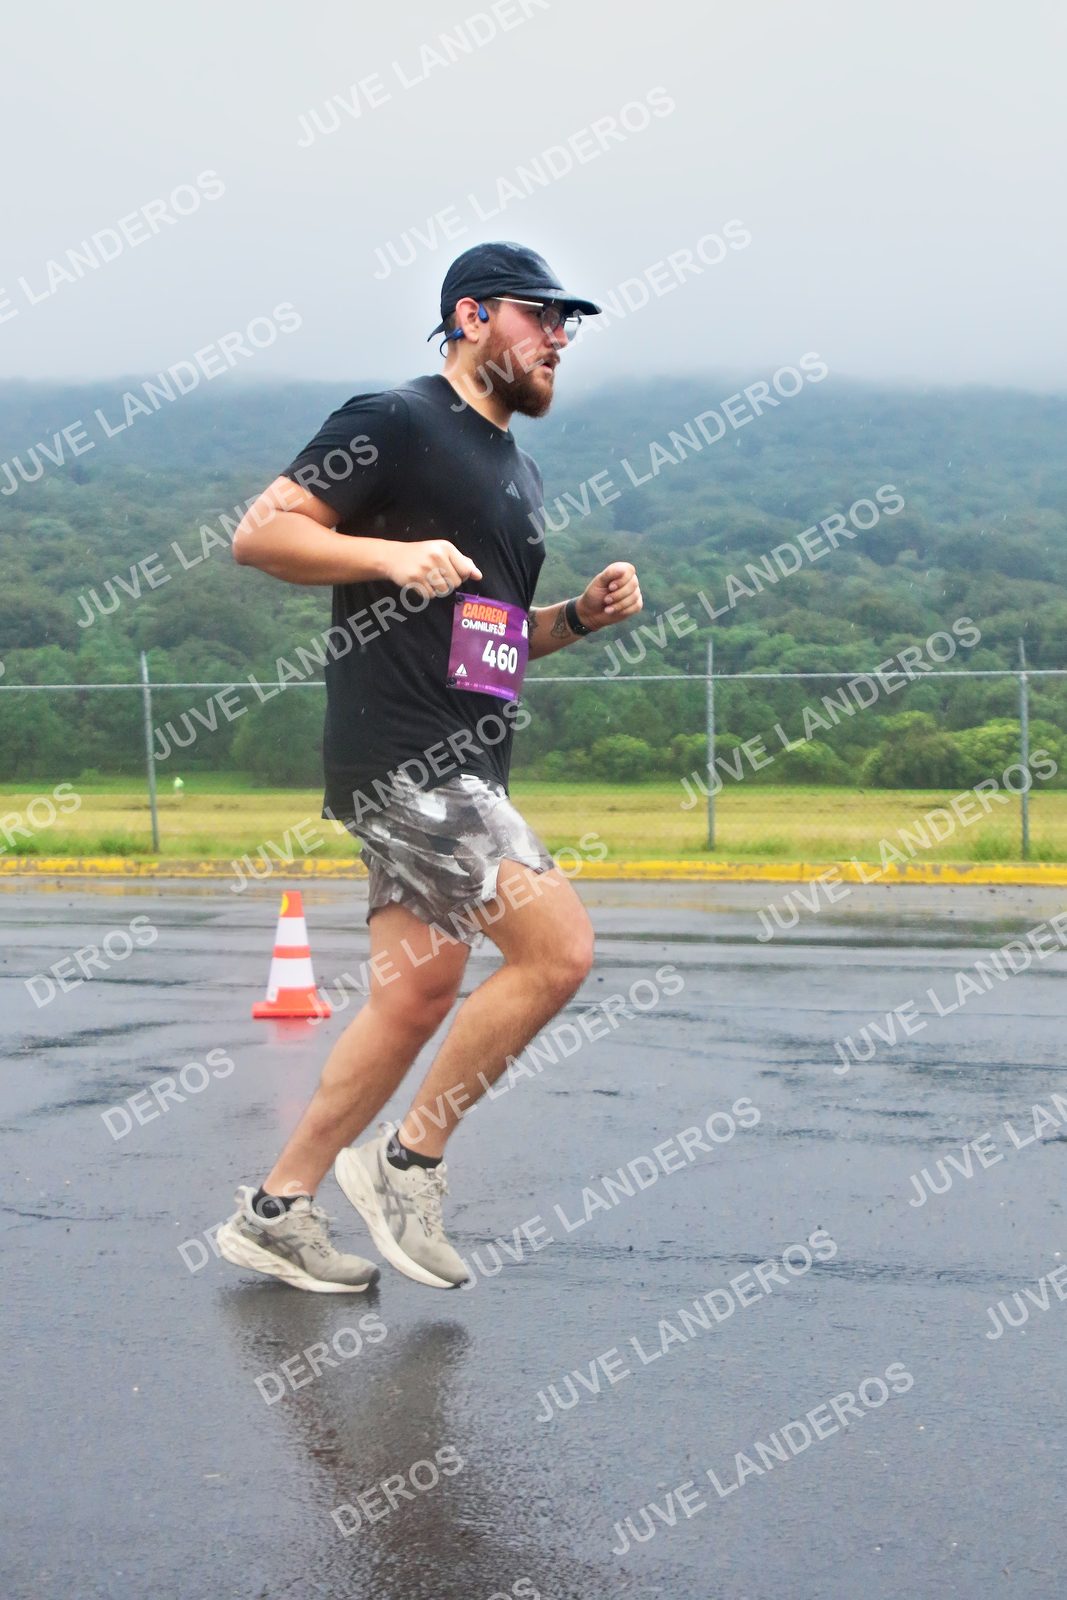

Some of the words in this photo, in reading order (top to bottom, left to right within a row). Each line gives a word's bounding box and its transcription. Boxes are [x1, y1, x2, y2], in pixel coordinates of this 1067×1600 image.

[463, 602, 507, 624] CARRERA
[461, 618, 499, 634] OMNILIFE
[482, 640, 518, 674] 460
